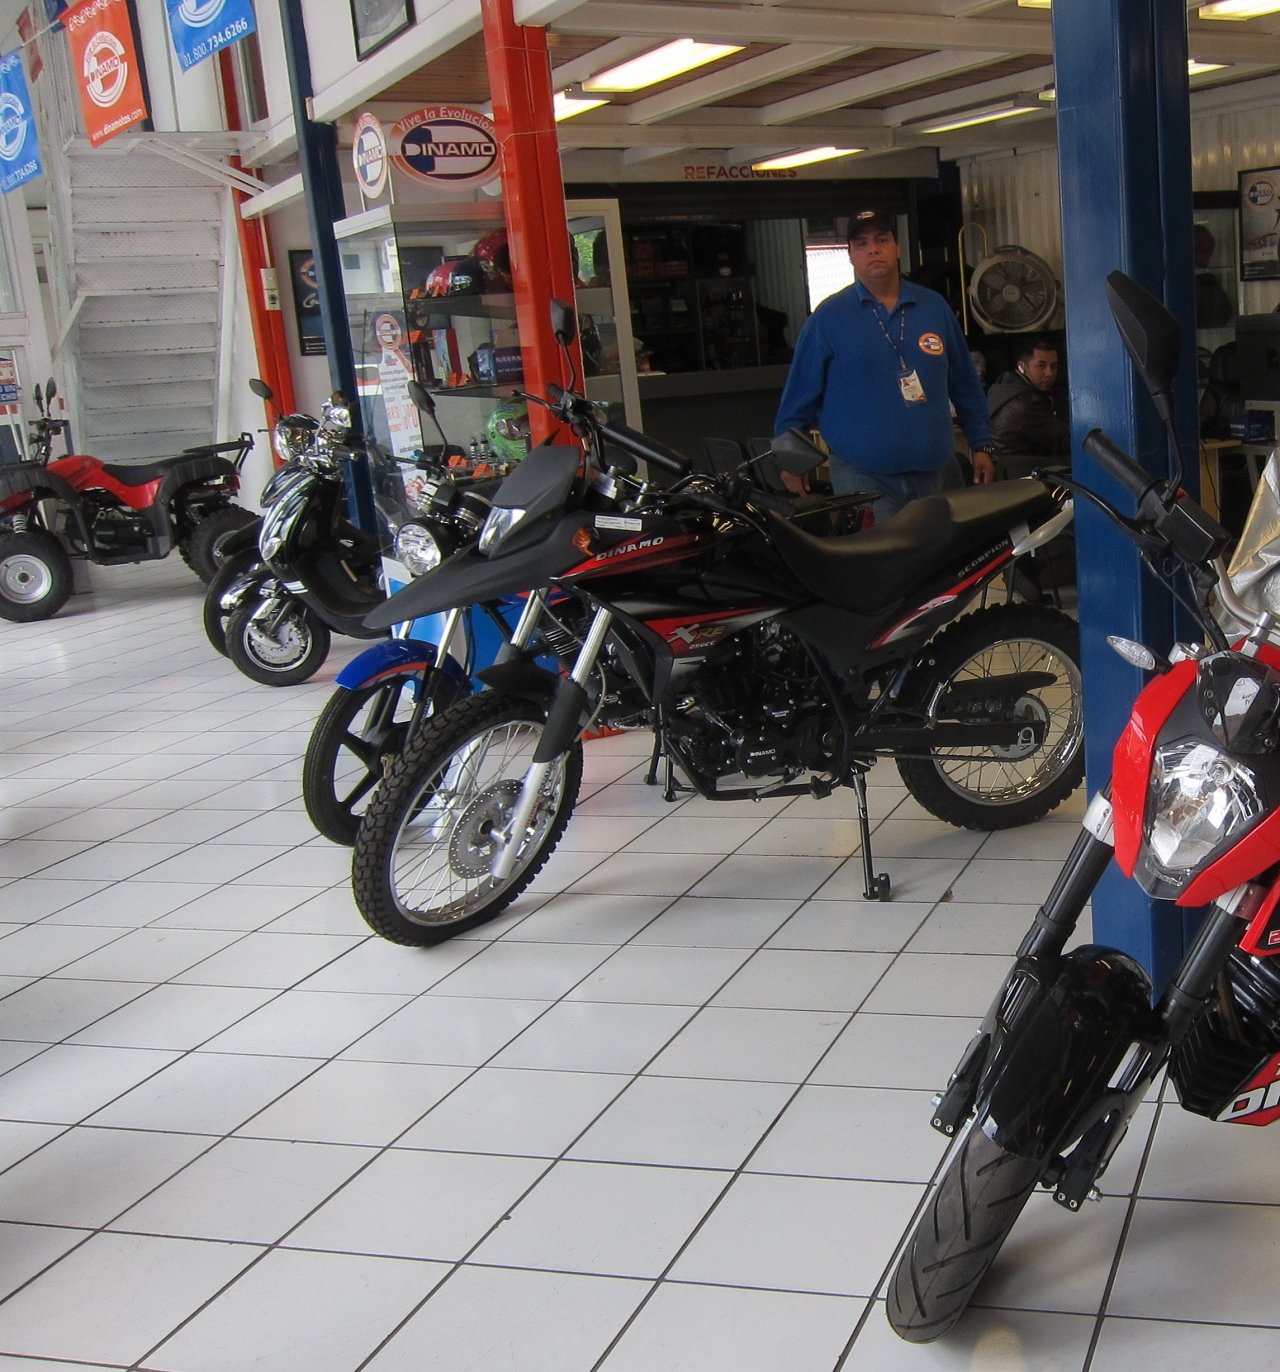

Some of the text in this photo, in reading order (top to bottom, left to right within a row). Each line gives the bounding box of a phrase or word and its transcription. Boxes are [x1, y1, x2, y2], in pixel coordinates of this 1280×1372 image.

[183, 17, 248, 65] 01.800.734.6266
[397, 115, 422, 132] Vive
[425, 110, 436, 119] la
[440, 106, 496, 133] Evolución
[405, 142, 496, 157] DINAMO
[684, 165, 799, 179] REFACCIONES
[595, 536, 664, 562] DINAMO
